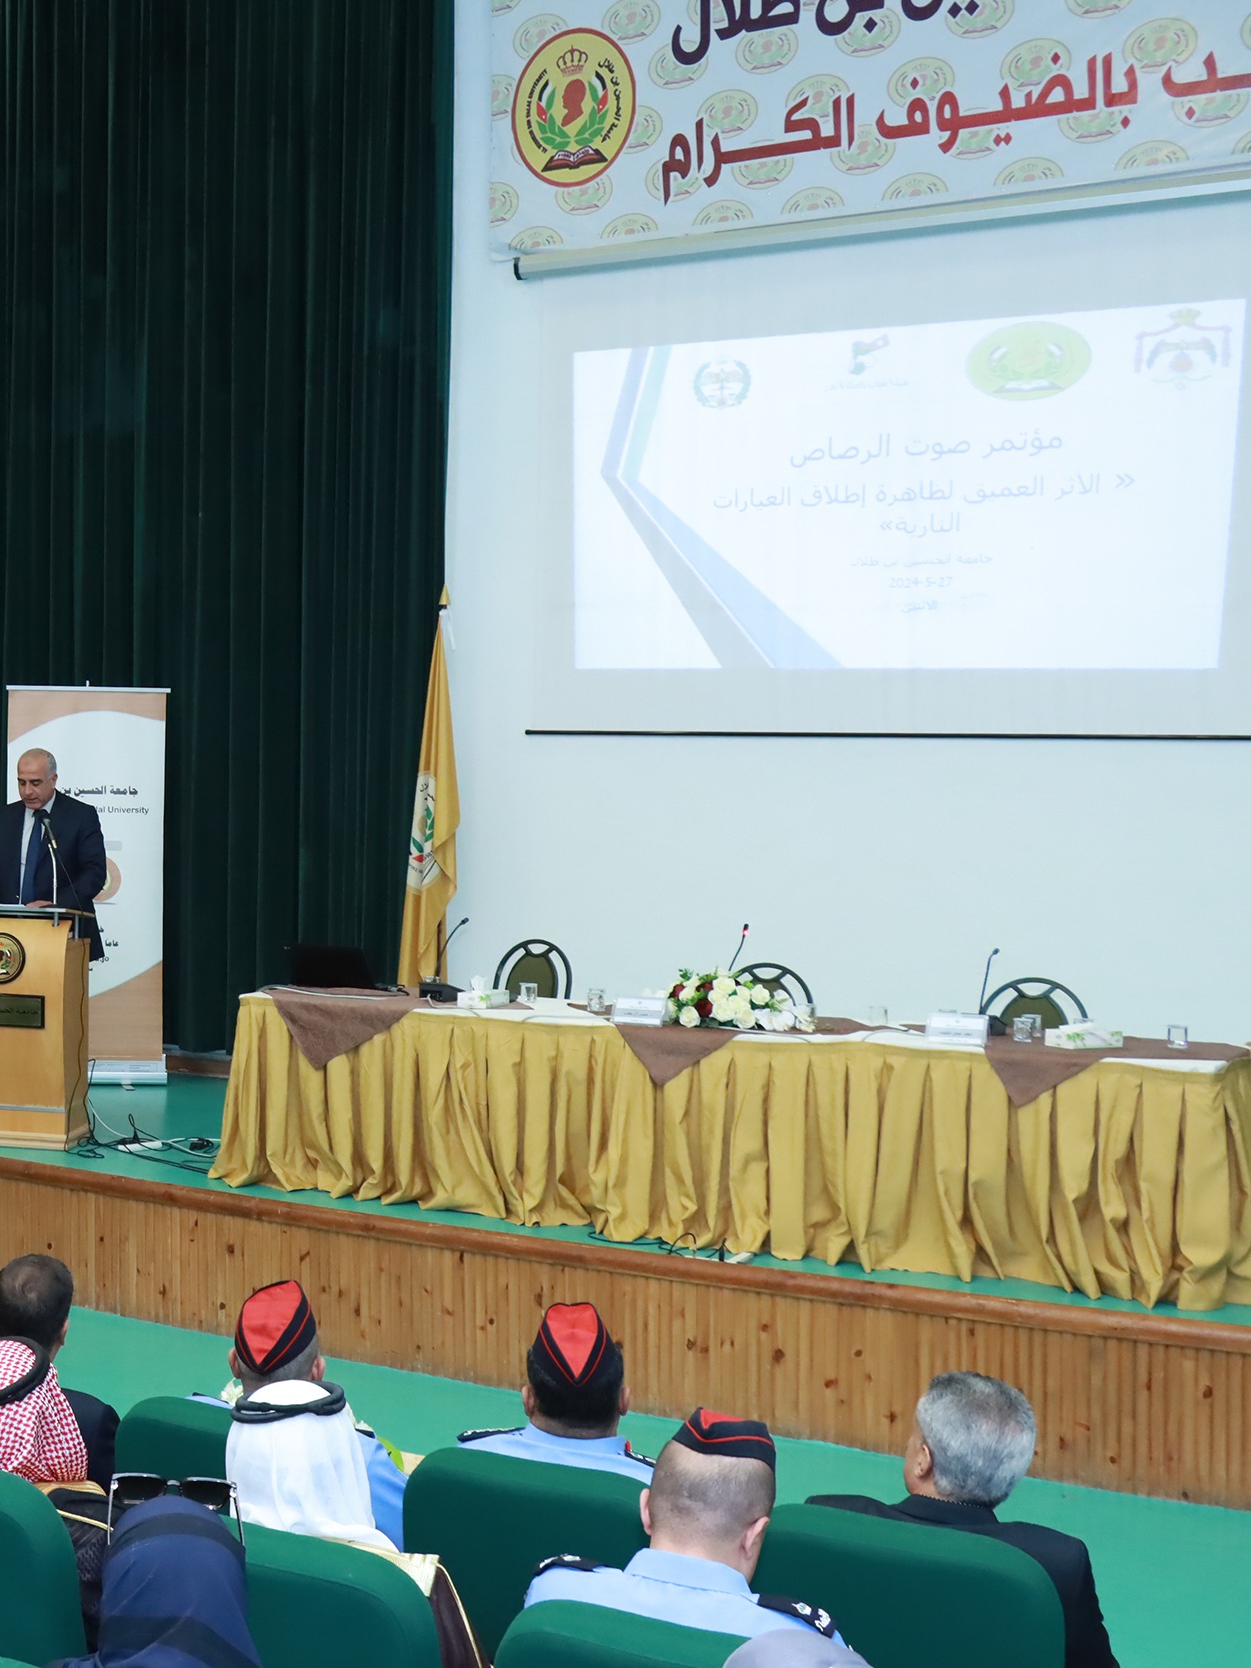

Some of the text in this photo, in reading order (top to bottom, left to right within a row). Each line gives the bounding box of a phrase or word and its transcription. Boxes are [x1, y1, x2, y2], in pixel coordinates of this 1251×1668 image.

[876, 51, 1138, 154] بالضيوف
[790, 427, 1063, 468] مؤتمر صوت الرصاص
[801, 483, 866, 508] إطلاق
[876, 479, 953, 506] لظاهرة
[74, 785, 107, 797] الحسين
[110, 785, 138, 797] جامعة
[108, 806, 150, 816] University
